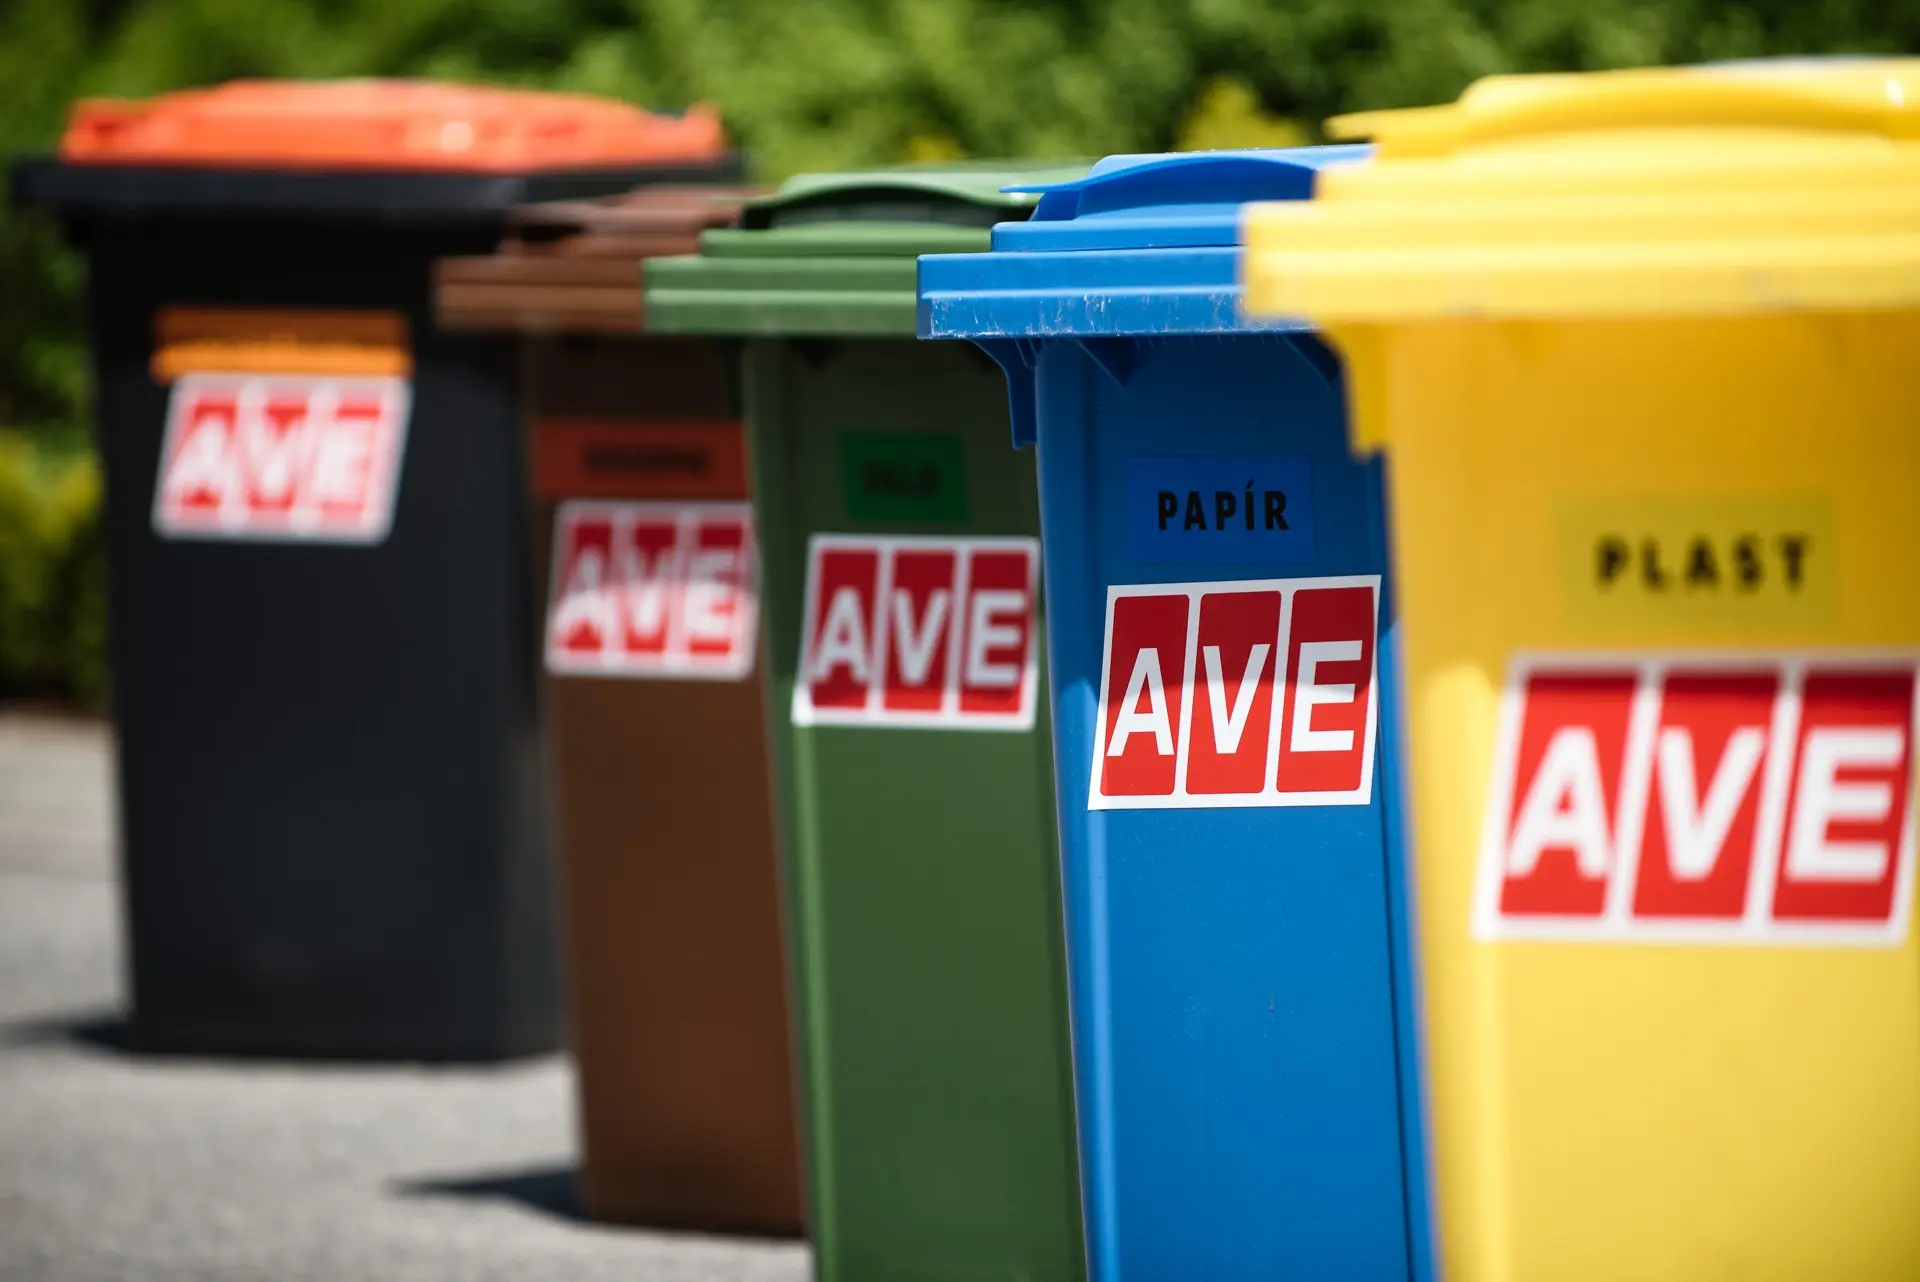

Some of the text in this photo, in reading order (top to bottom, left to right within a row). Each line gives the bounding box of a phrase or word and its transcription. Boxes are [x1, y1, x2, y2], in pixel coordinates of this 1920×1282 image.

[166, 414, 376, 499] AVE
[1157, 479, 1290, 531] PAPÍR
[554, 550, 738, 638] AVE
[1596, 533, 1808, 593] PLAST
[809, 586, 1024, 686] AVE
[1107, 640, 1363, 757] AVE
[1506, 727, 1904, 881] AVE
